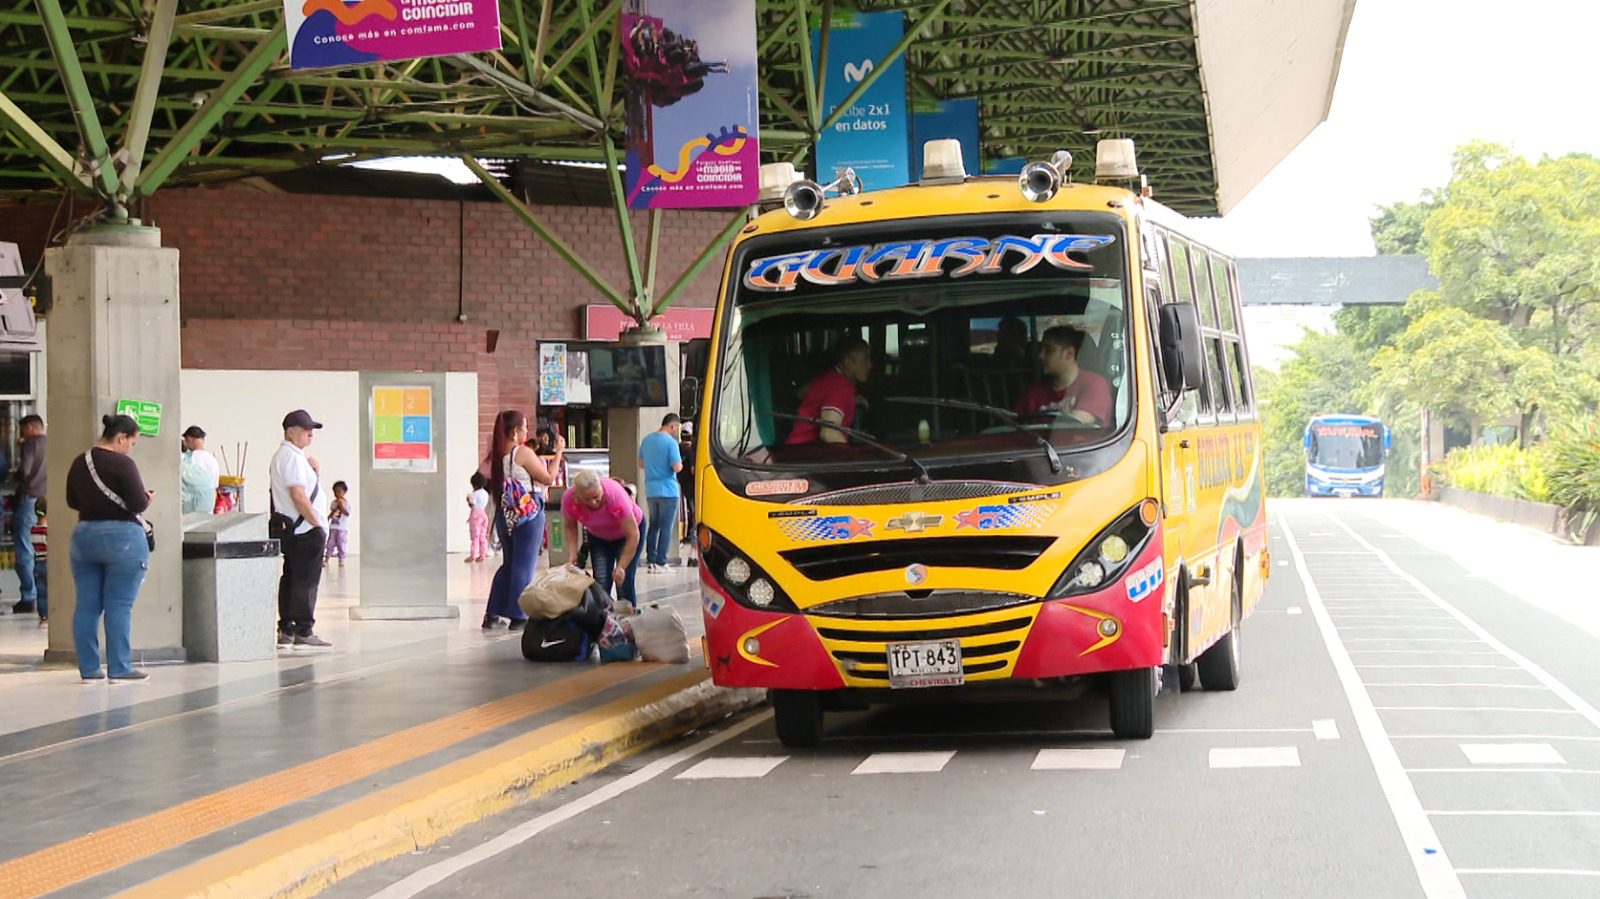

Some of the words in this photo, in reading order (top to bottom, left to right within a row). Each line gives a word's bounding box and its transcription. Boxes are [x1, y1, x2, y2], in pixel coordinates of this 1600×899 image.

[402, 2, 473, 22] COINCIDIR
[313, 33, 354, 45] Conoce
[358, 30, 380, 40] más
[400, 21, 475, 36] comfama.com
[829, 105, 865, 117] Rcibe
[868, 104, 890, 116] 2x1
[835, 121, 850, 132] en
[852, 119, 887, 131] datos
[743, 234, 1115, 292] GUARNE
[406, 395, 415, 409] 2
[406, 424, 415, 436] 4
[892, 650, 920, 668] TPT
[926, 647, 957, 666] 843
[911, 676, 963, 686] CHEVROLET
